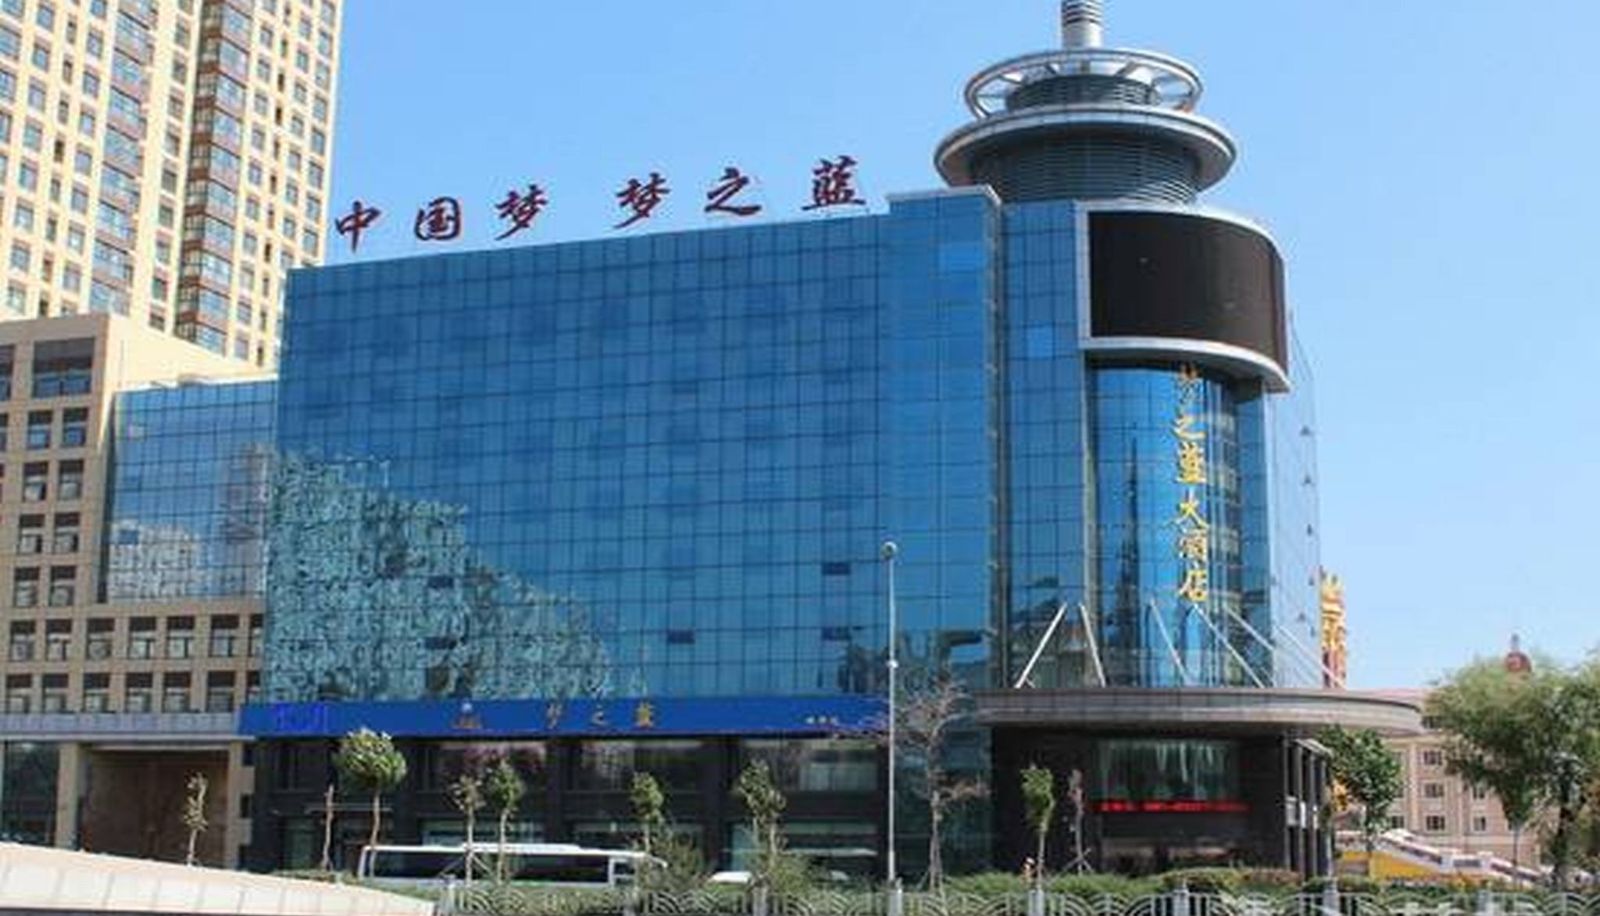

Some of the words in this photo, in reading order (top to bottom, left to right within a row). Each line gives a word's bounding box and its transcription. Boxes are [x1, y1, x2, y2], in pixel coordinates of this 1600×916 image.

[335, 184, 548, 252] 中国梦
[613, 155, 866, 228] 梦之蓝
